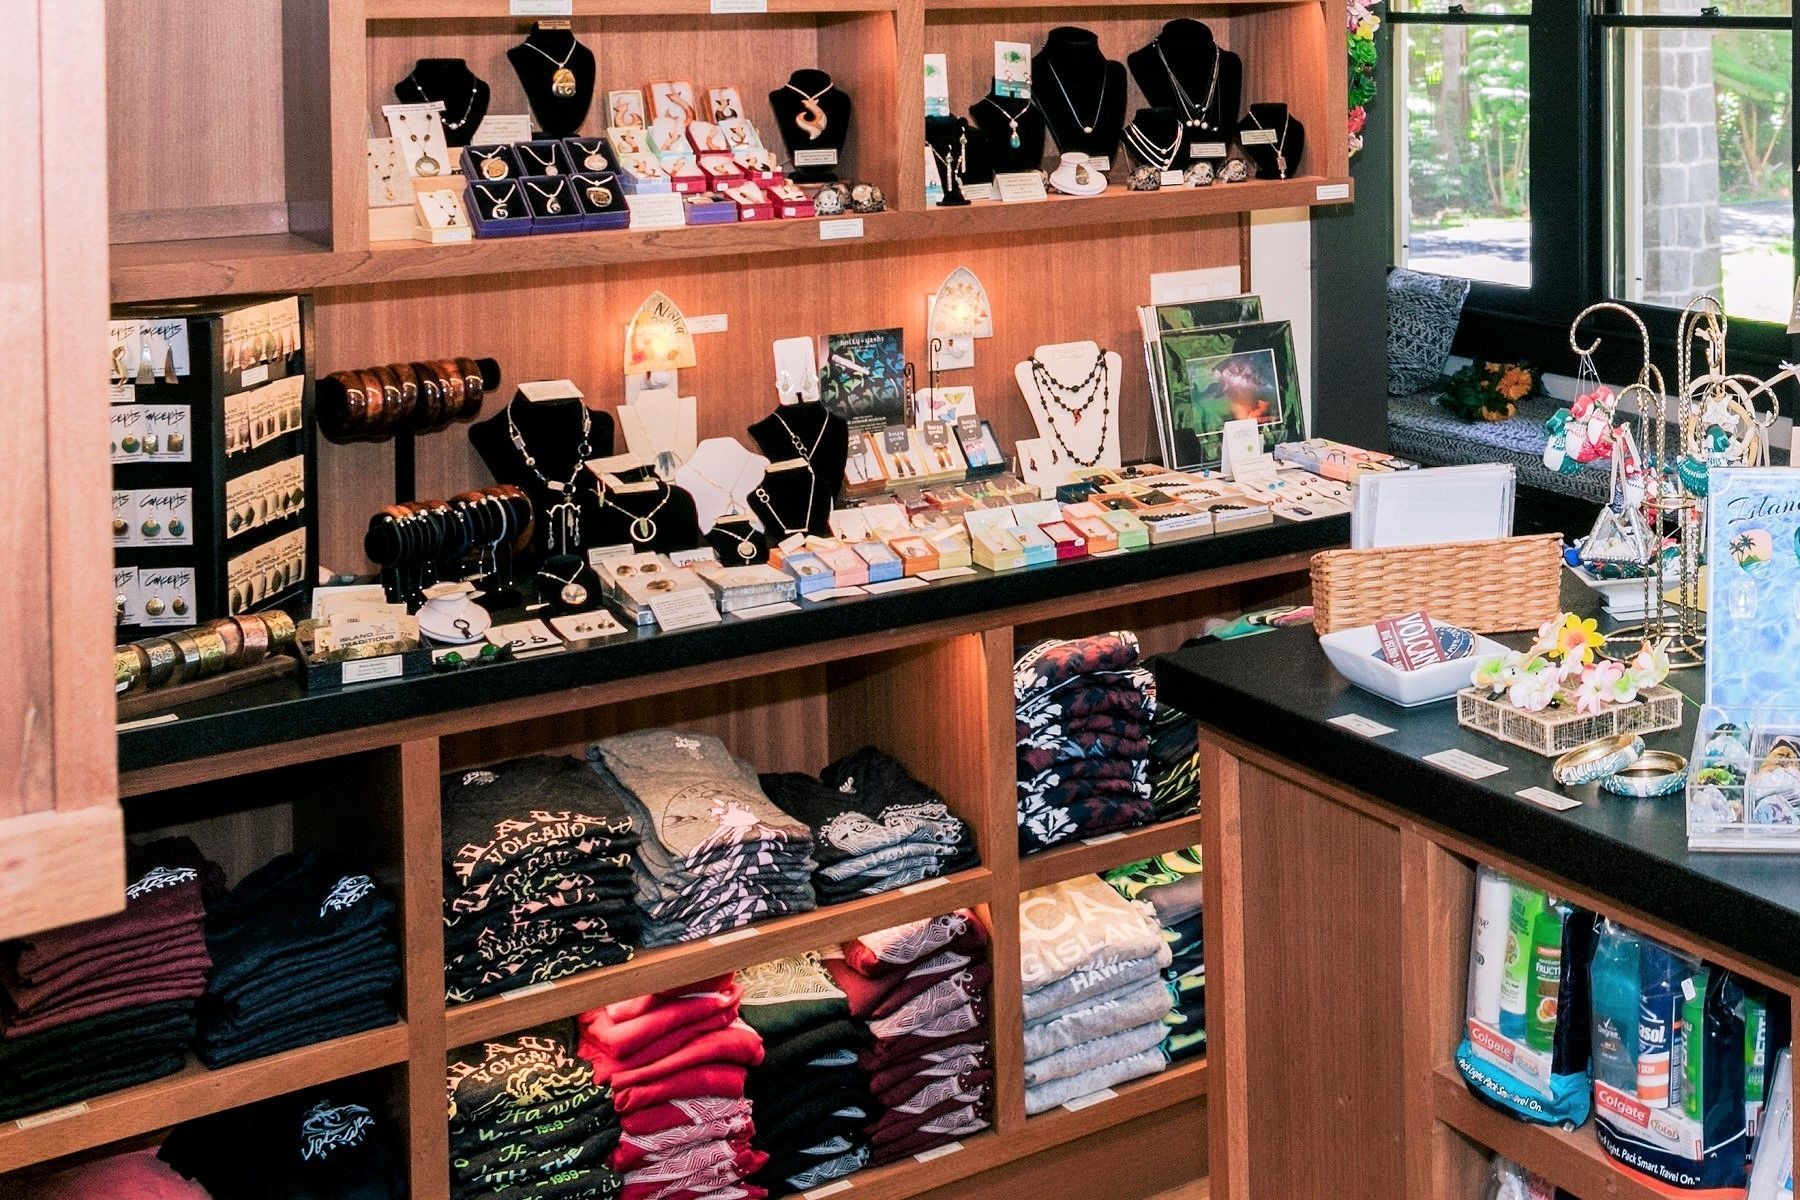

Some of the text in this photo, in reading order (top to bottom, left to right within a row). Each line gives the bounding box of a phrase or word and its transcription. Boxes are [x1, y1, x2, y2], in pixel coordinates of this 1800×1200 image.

[654, 302, 686, 336] Aloha
[110, 324, 135, 341] epts
[140, 323, 182, 341] oncepts
[840, 338, 860, 347] holly
[111, 410, 140, 428] cepts
[145, 409, 186, 426] oncepts
[140, 492, 187, 511] Concepts
[145, 571, 191, 590] Concepts
[340, 632, 373, 643] ISLAND
[341, 634, 394, 649] TRADITIONS
[485, 821, 586, 865] VOLCANO
[1477, 917, 1489, 930] ove
[1043, 919, 1151, 971] ISLAN
[1536, 961, 1561, 977] FRUCTI
[1598, 1024, 1619, 1039] Degree
[1639, 1025, 1666, 1043] asol.
[1472, 1027, 1512, 1057] Colgate
[1641, 1064, 1656, 1075] SKIN
[1458, 1058, 1469, 1072] Pack
[1482, 1075, 1498, 1093] Pack
[1529, 1099, 1543, 1113] On.
[1599, 1089, 1645, 1122] Colgate
[1651, 1121, 1678, 1140] Total
[1607, 1137, 1621, 1157] Light.
[1621, 1145, 1637, 1163] Pack
[1636, 1154, 1659, 1173] Smart.
[1658, 1162, 1680, 1182] Travel
[550, 1169, 579, 1185] 1959
